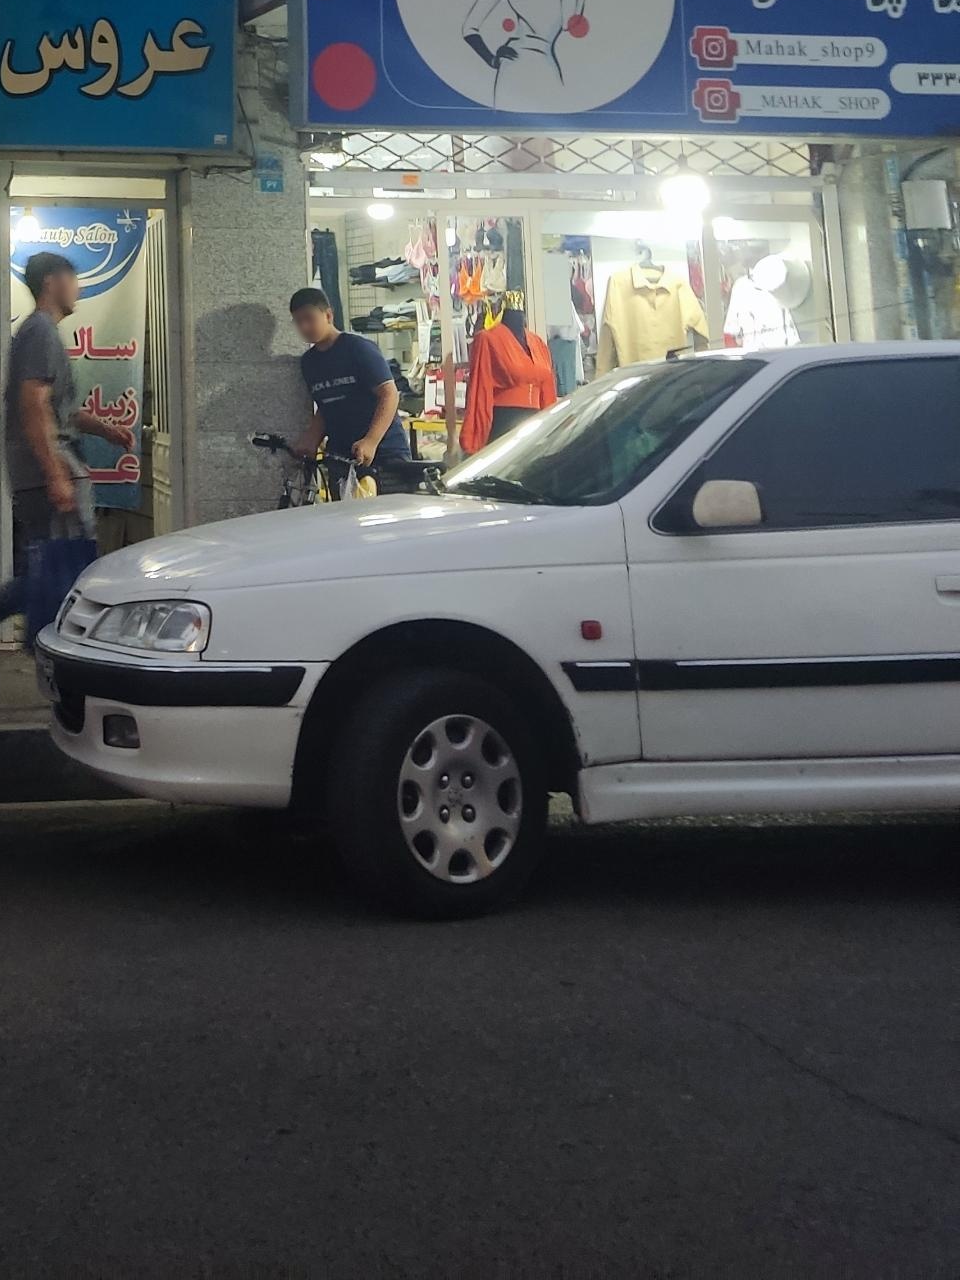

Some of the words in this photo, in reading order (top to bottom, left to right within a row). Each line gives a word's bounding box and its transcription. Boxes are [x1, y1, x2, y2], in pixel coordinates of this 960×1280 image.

[25, 227, 73, 245] auty
[75, 225, 117, 243] Salon
[64, 326, 137, 359] سال
[80, 384, 138, 428] زیبا
